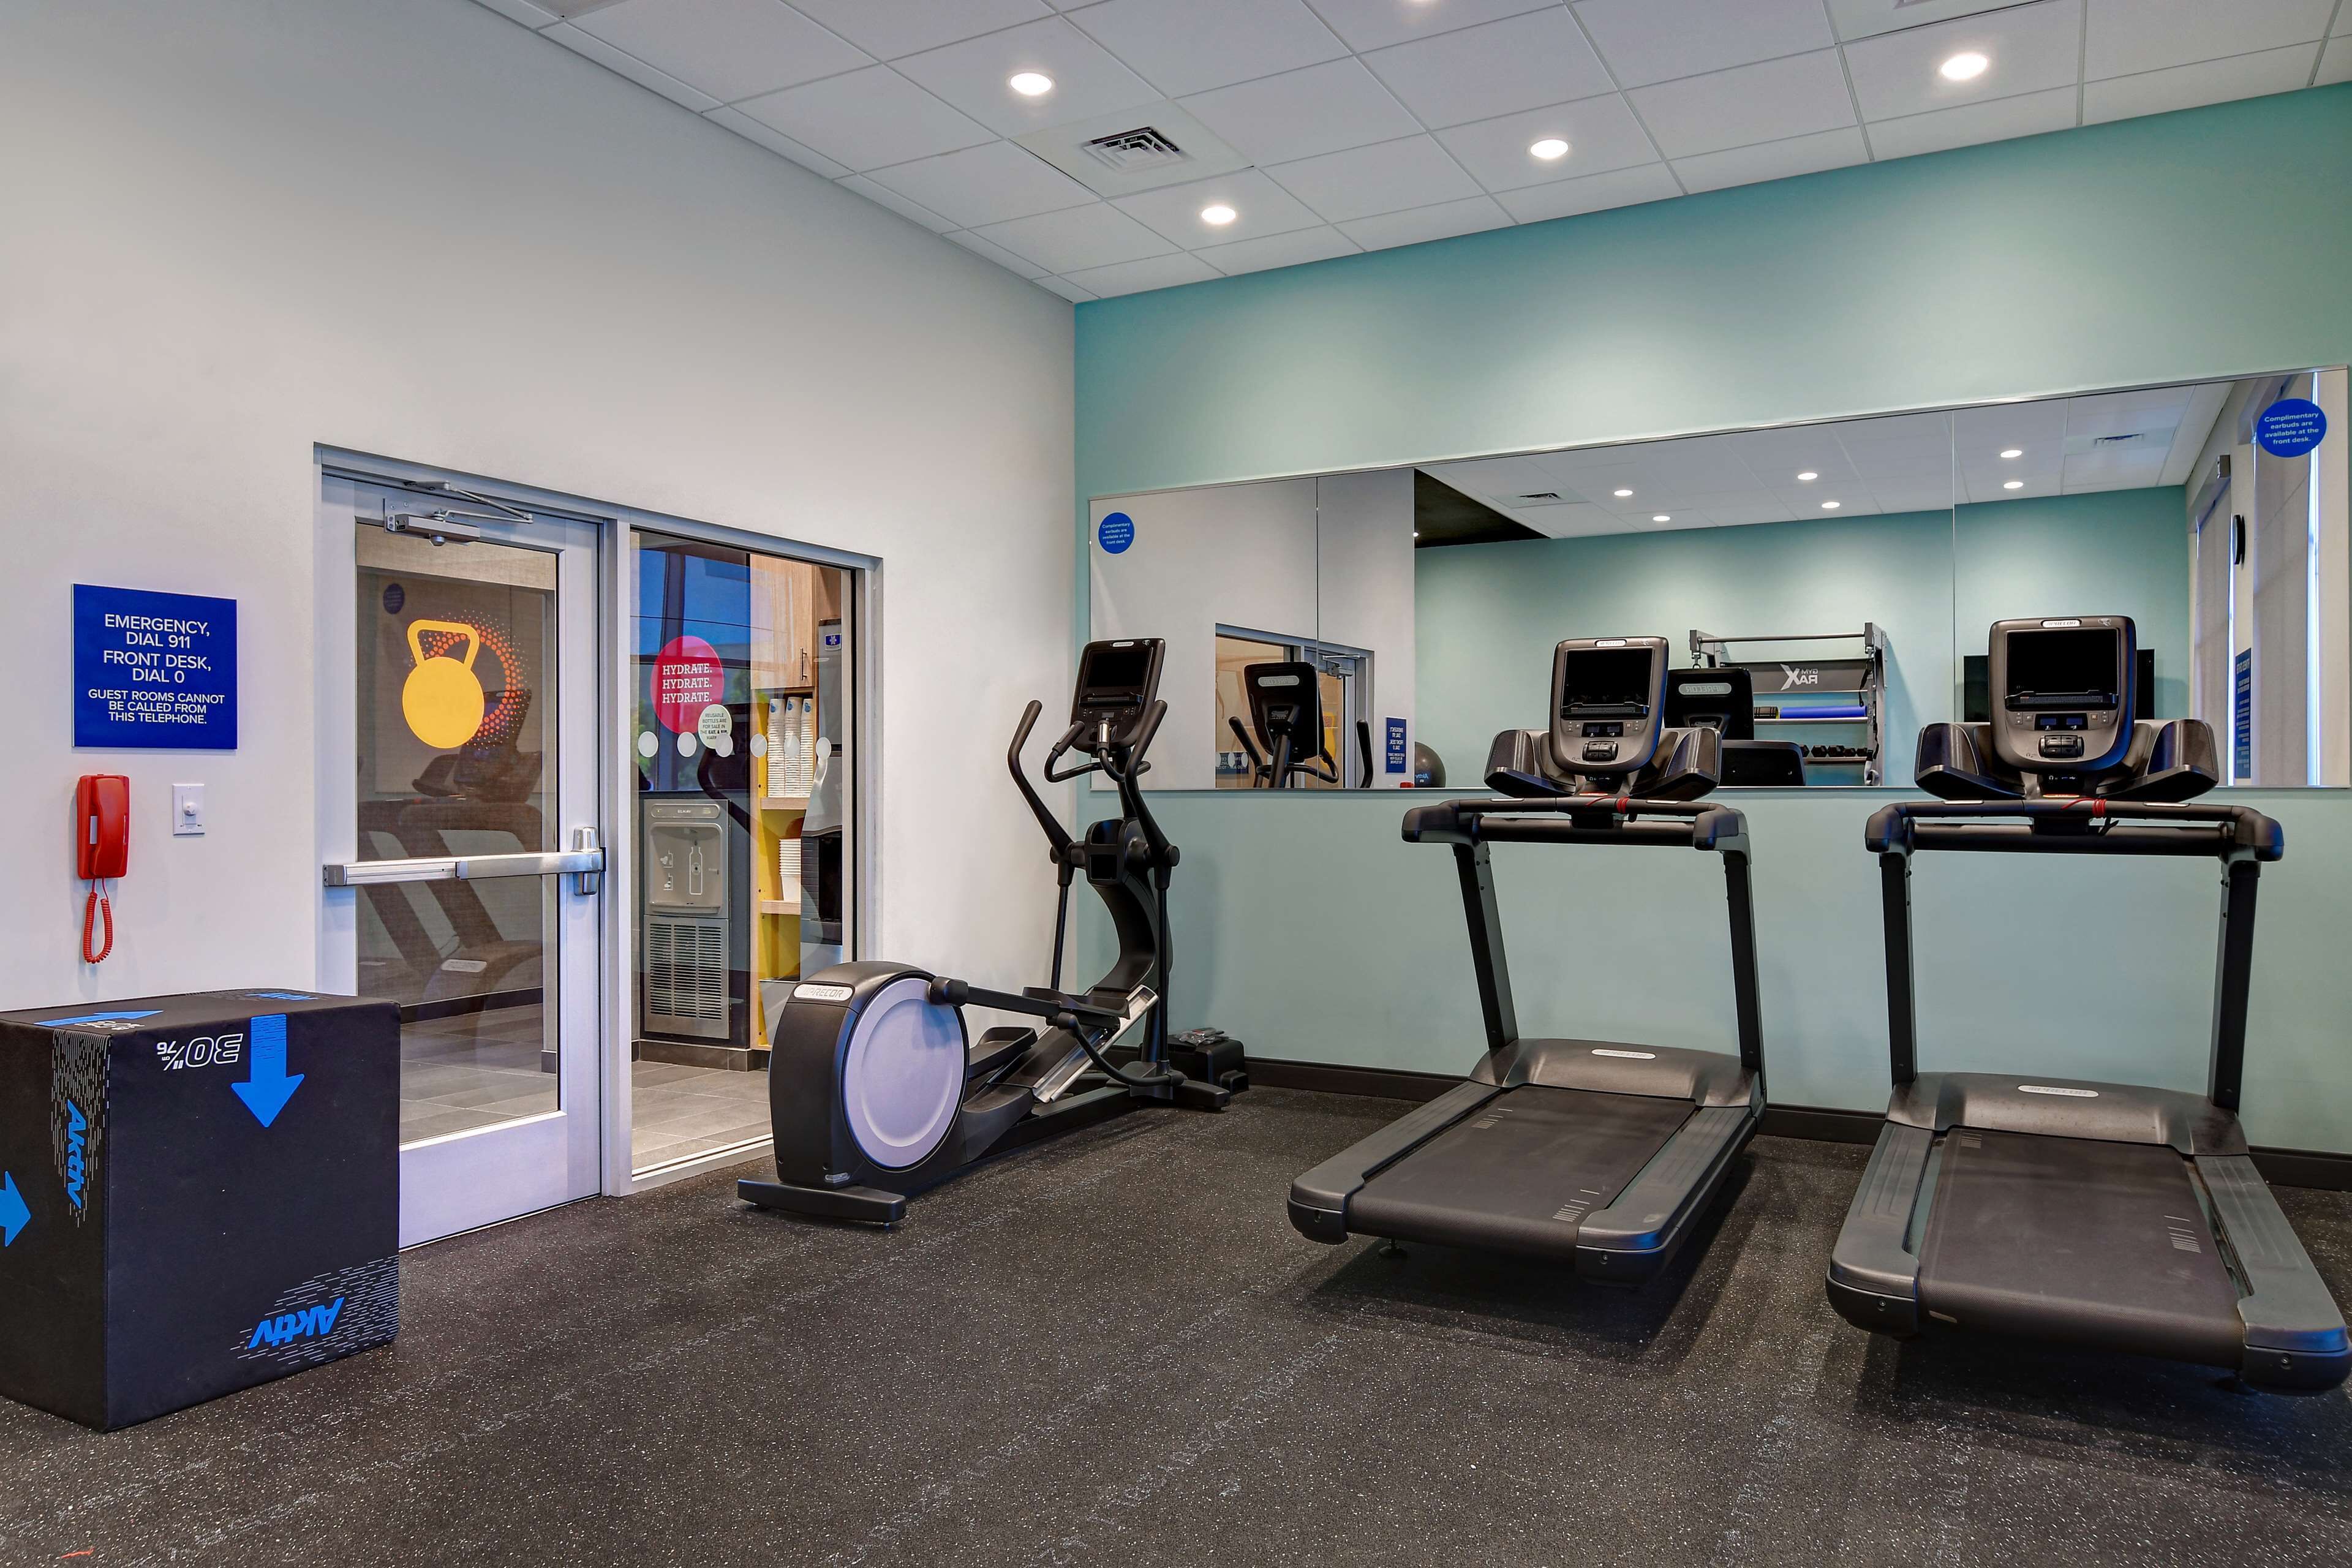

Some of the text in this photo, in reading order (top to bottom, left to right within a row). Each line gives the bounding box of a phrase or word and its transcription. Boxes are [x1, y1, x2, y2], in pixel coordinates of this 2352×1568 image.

[2264, 412, 2319, 422] Complimentary
[2265, 429, 2296, 438] available
[105, 614, 210, 637] EMERGENCY,
[126, 631, 190, 649] DIAL 911
[104, 650, 211, 671] FRONT DESK,
[132, 668, 185, 684] DIAL 0
[662, 663, 712, 676] HYDRATE.
[662, 677, 712, 690] HYDRATE.
[88, 689, 225, 704] GUEST ROOMS CANNOT
[662, 692, 712, 704] HYDRATE.
[109, 701, 206, 714] BE CALLED FROM
[108, 712, 207, 725] THIS TELEPHONE.
